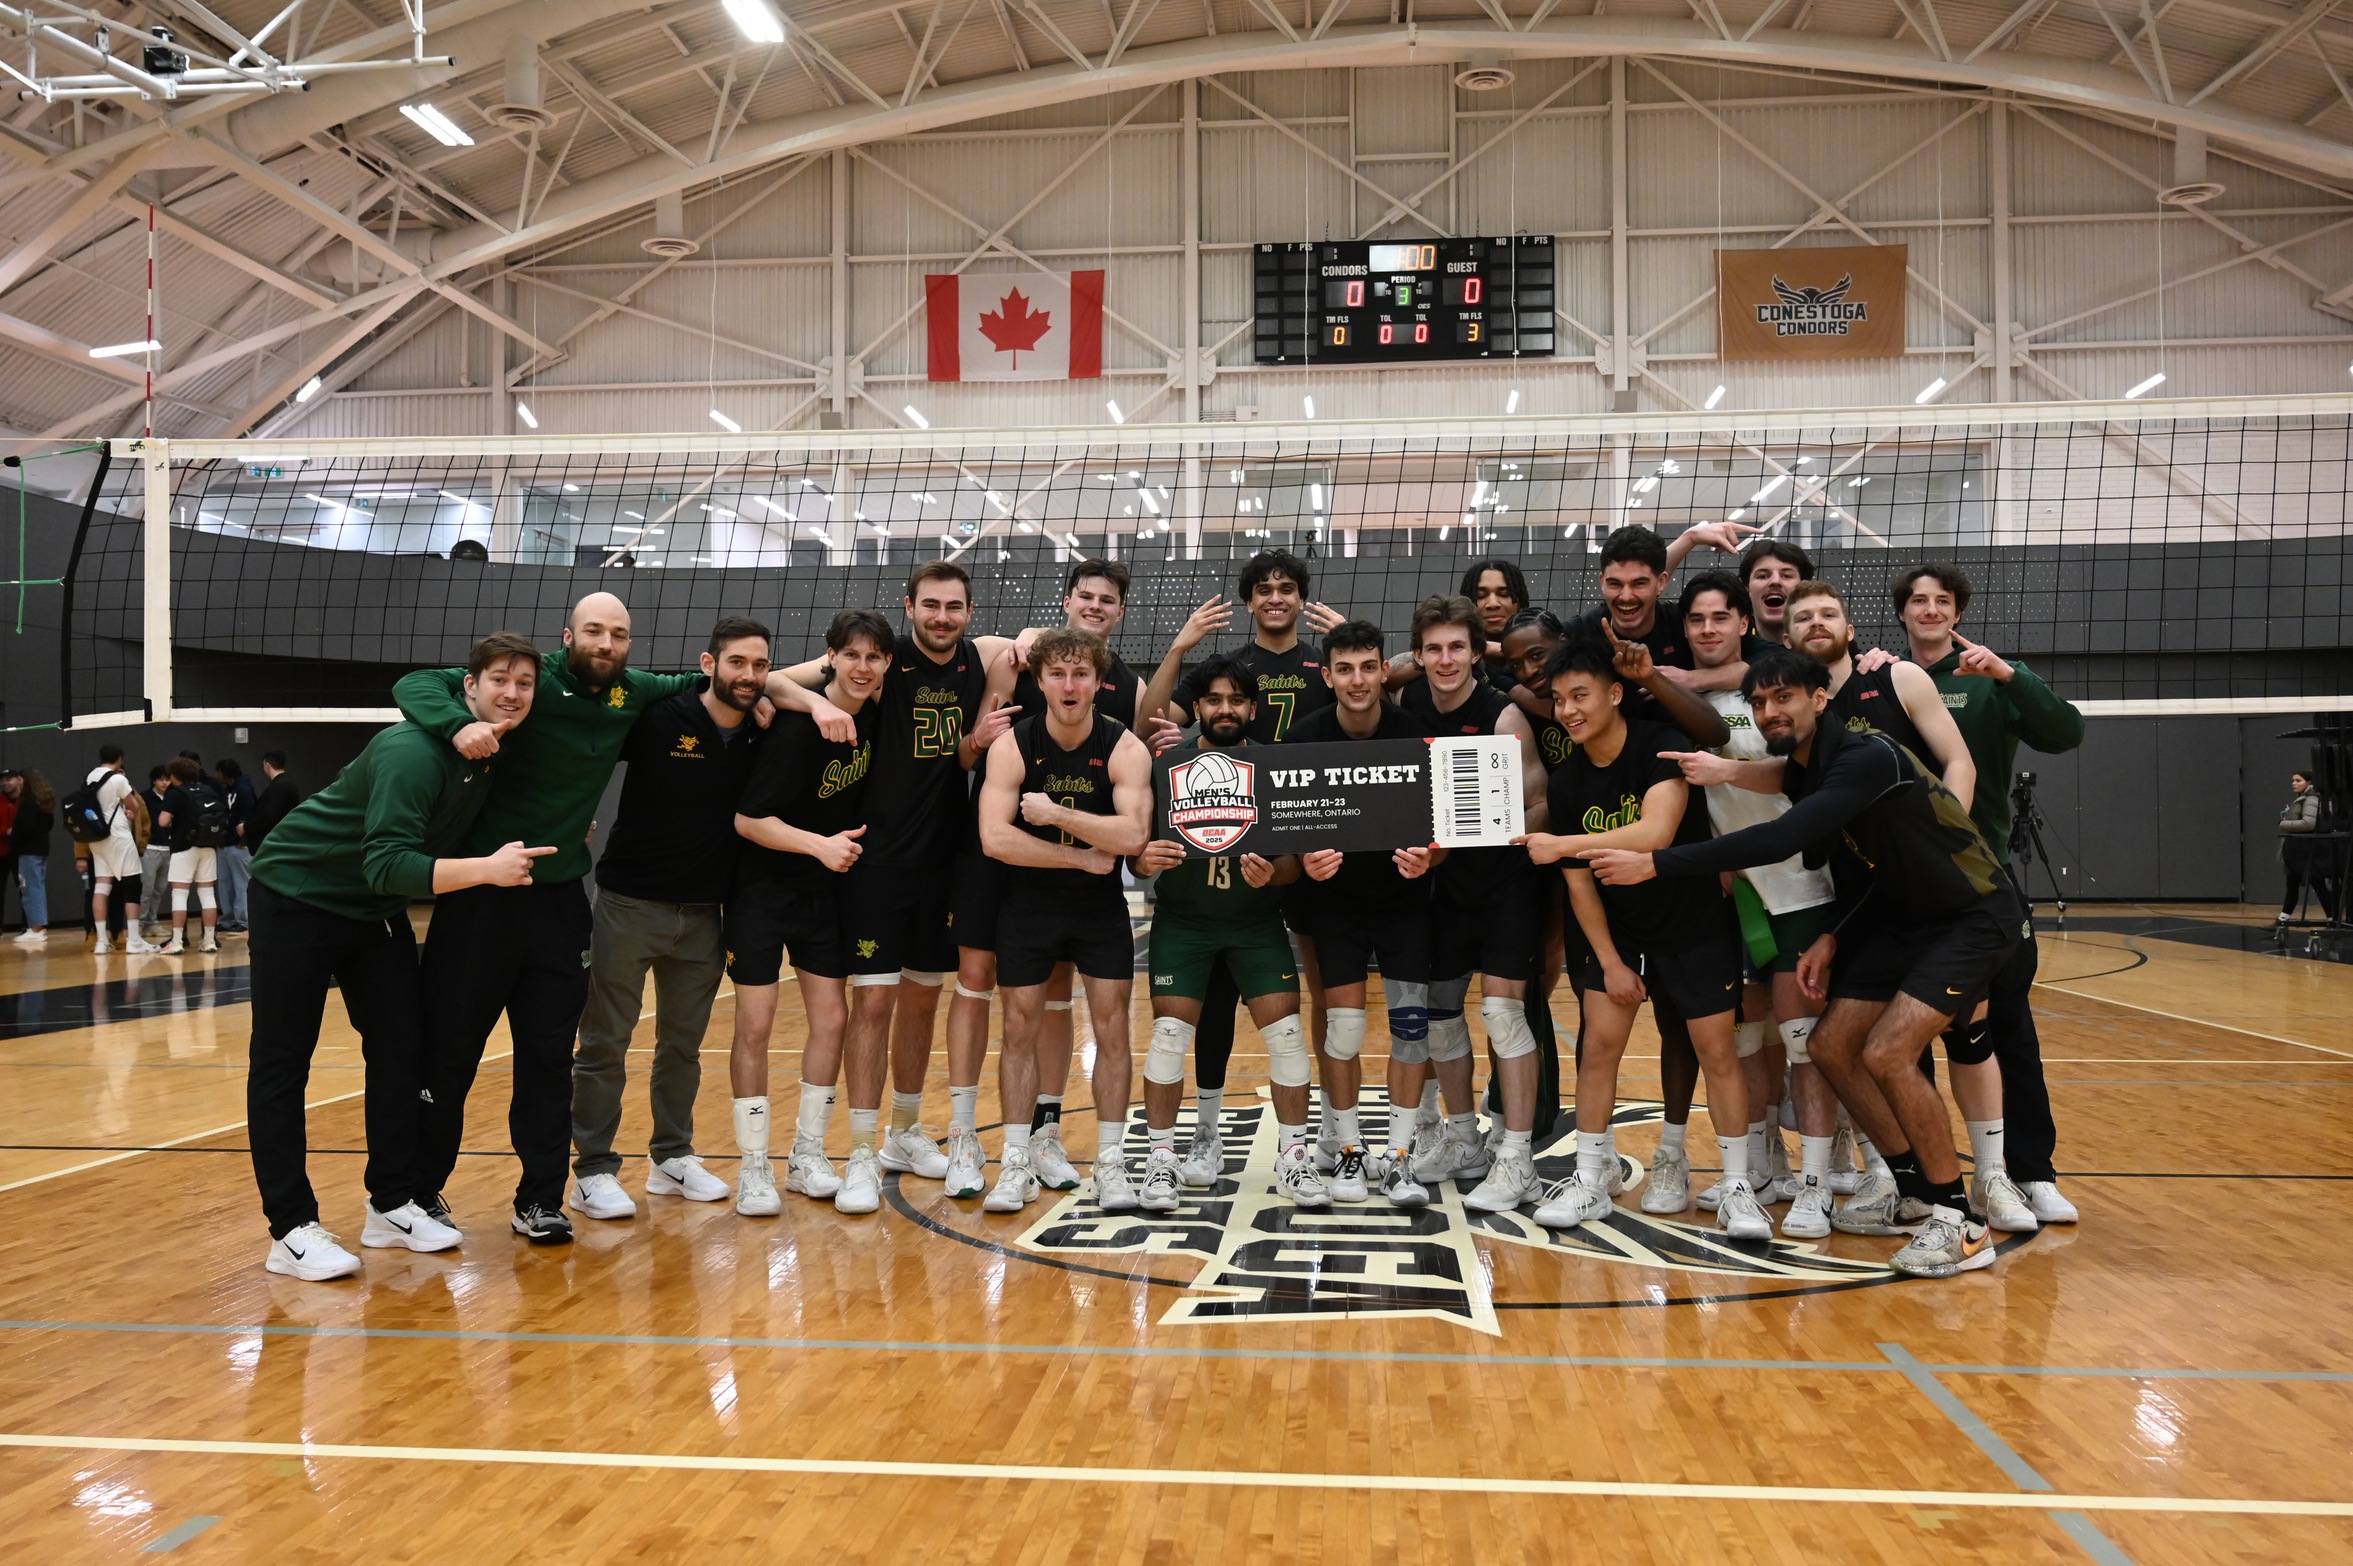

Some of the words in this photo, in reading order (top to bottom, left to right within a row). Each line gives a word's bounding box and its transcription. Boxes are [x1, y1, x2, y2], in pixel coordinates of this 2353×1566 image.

[1262, 244, 1272, 252] NO
[1299, 243, 1313, 251] PTS
[1496, 238, 1507, 246] NO
[1522, 237, 1527, 245] F
[1534, 236, 1548, 244] PTS
[1321, 265, 1368, 277] CONDORS
[1446, 262, 1478, 273] GUEST
[1390, 275, 1416, 284] PERIOD
[1346, 280, 1363, 307] 0
[1398, 287, 1409, 305] 3
[1464, 278, 1481, 304] 0
[1380, 314, 1392, 322] TOL
[1459, 312, 1469, 320] TM
[1755, 303, 1867, 322] CONESTOGA
[1333, 326, 1346, 345] 0
[1380, 324, 1392, 344] 0
[1415, 324, 1428, 343] 0
[1467, 323, 1479, 342] 3
[1776, 320, 1848, 336] CONDORS
[1257, 674, 1307, 691] Saints
[1268, 692, 1295, 742] 7
[913, 706, 963, 758] 20
[670, 751, 705, 759] VOLLEYBALL
[818, 740, 872, 798] Saint
[1269, 769, 1316, 788] VIP
[1324, 764, 1420, 786] TICKET
[1044, 774, 1094, 792] Saints
[1194, 788, 1231, 797] MEN'S
[1173, 797, 1252, 810] VOLLEYBALL
[1270, 799, 1318, 809] FEBRUARY
[1320, 798, 1346, 807] 21-23
[1173, 809, 1254, 823] CHAMPIONSHIP
[1271, 809, 1323, 819] SOMEWHERE,
[1324, 808, 1361, 817] ONTARIO
[1504, 809, 1512, 833] TEAMS
[1202, 828, 1226, 837] OCAA
[1208, 856, 1230, 890] 13
[1154, 975, 1174, 985] SAINTS
